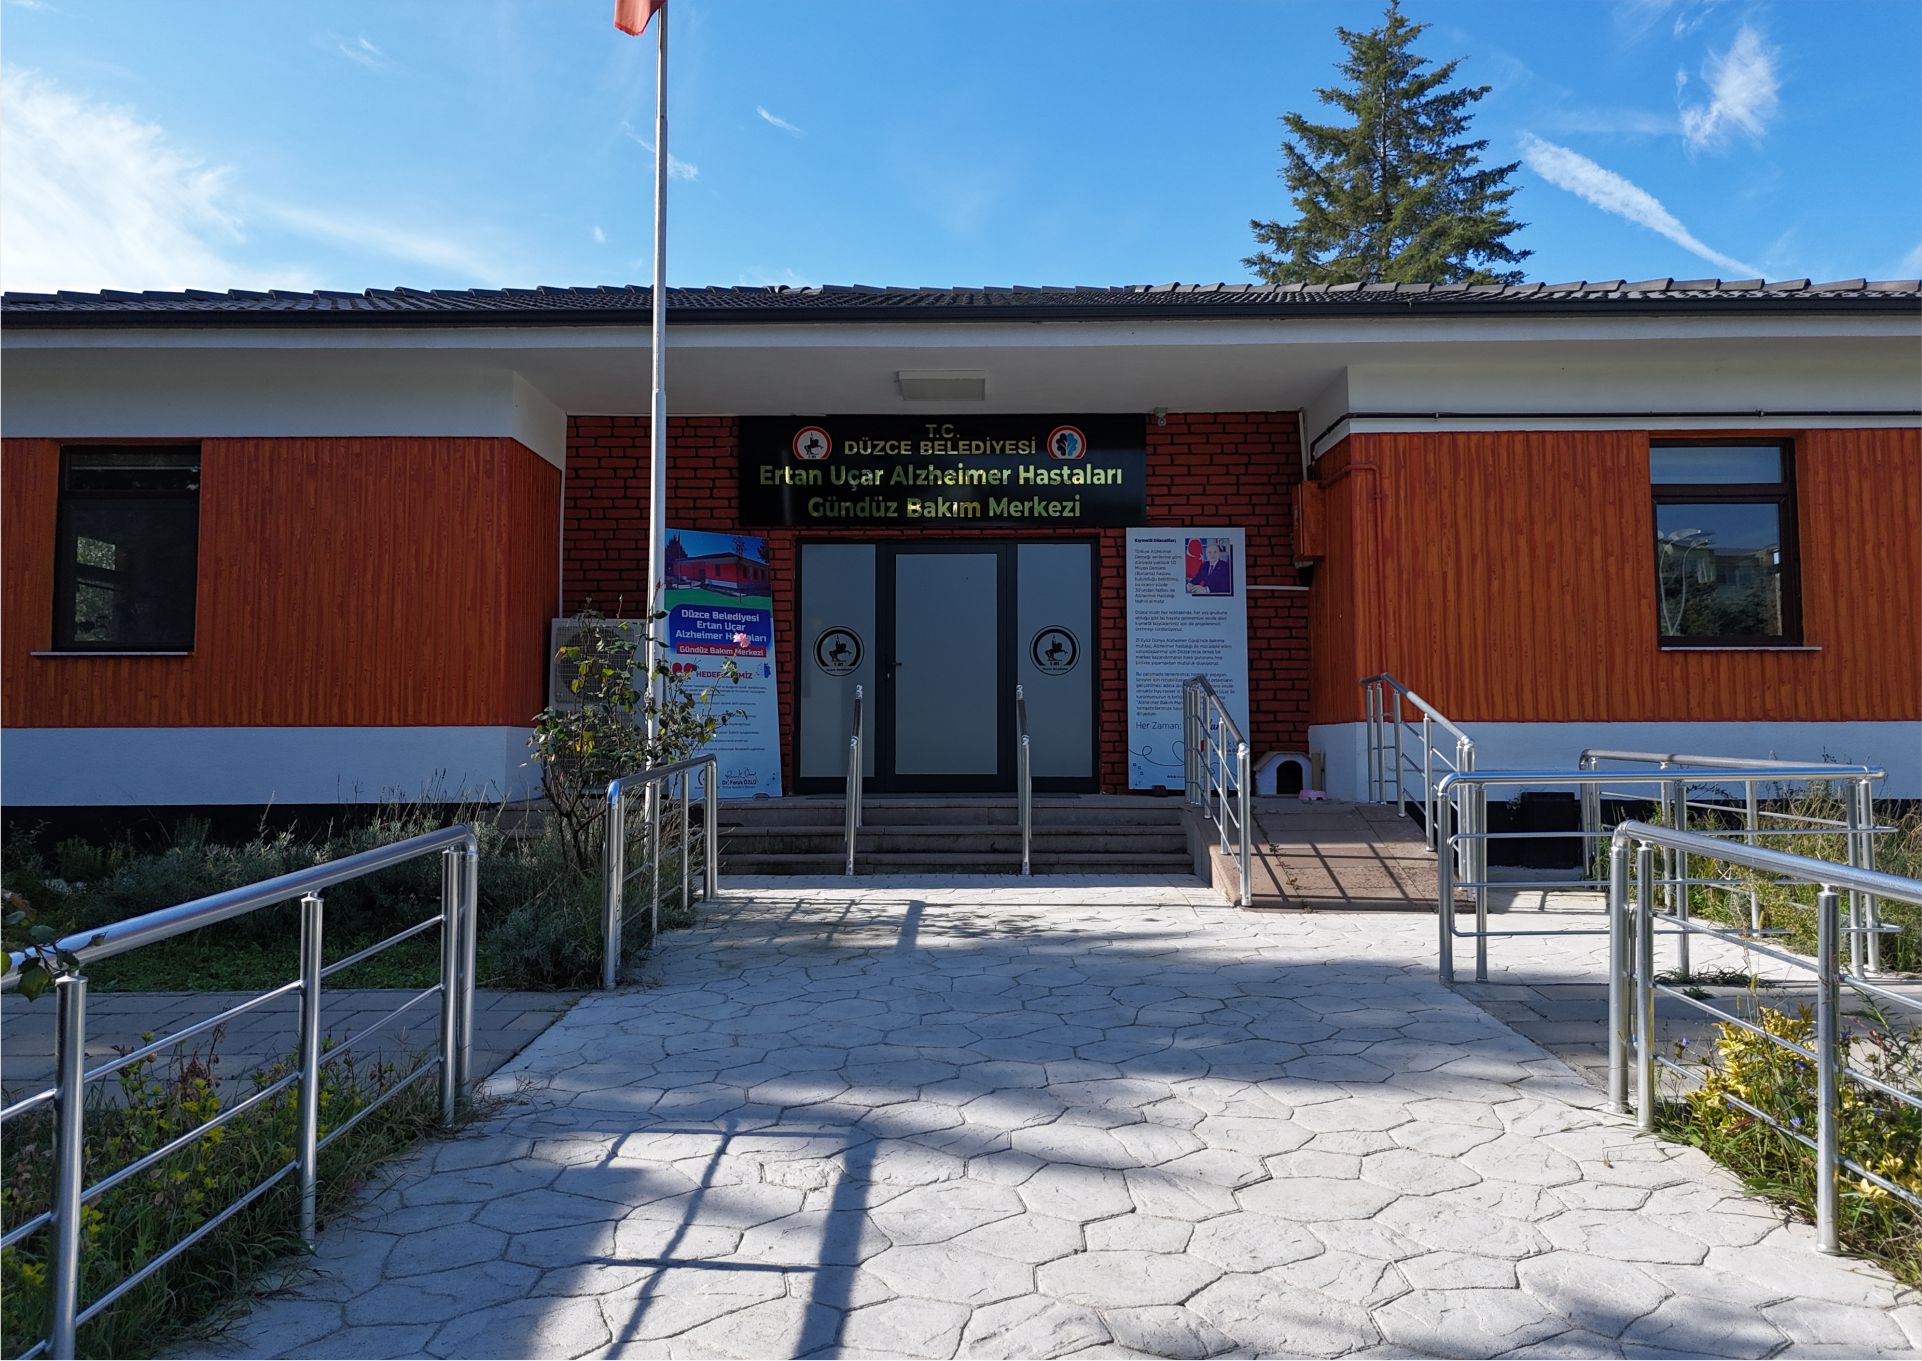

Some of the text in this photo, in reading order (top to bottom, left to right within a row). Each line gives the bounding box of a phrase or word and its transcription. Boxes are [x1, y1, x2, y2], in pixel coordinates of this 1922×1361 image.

[925, 424, 960, 438] T.C.
[844, 437, 1036, 455] DÜZCE BELEDİYESİ
[759, 463, 1123, 492] Ertan Uçar Alzheimer Hastaları
[808, 494, 1081, 518] Gündüz Bakım Merkezi
[681, 609, 760, 623] Düzce Belediyesi
[696, 620, 747, 632] Ertan Uçar
[675, 629, 767, 642] Alzheimer Haları
[679, 645, 709, 654] Gündüz
[1135, 721, 1150, 730] Her
